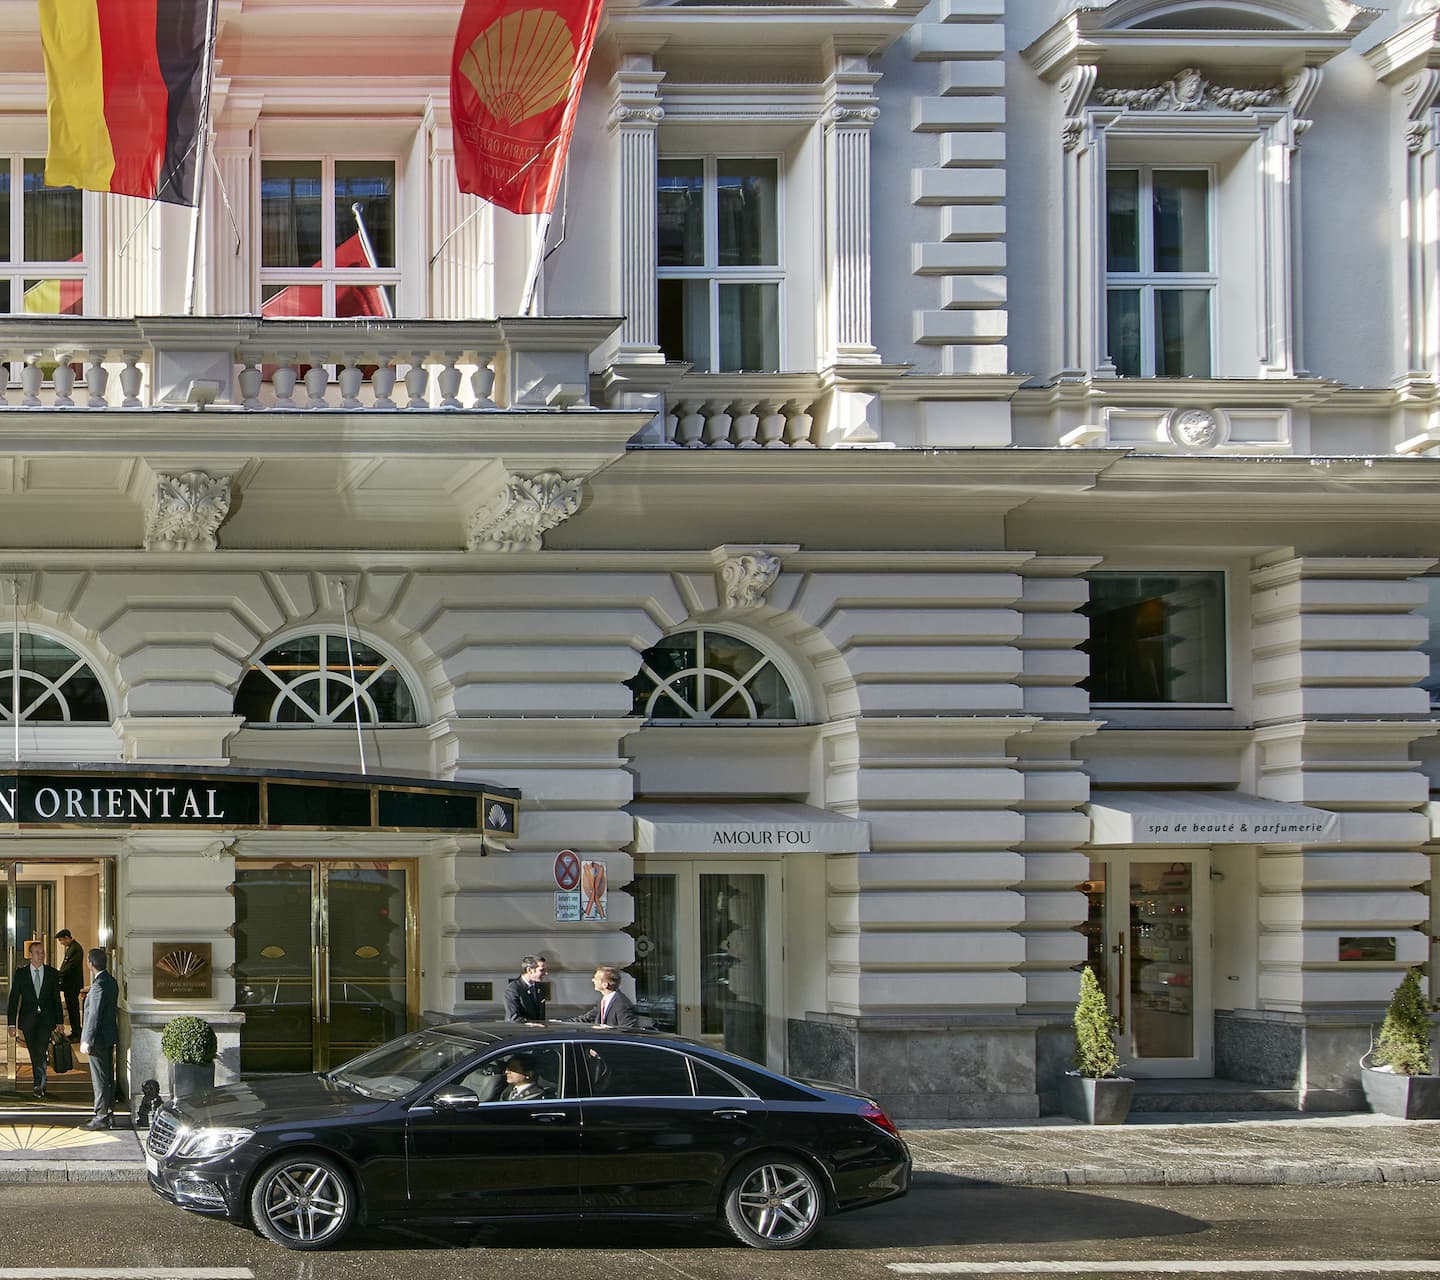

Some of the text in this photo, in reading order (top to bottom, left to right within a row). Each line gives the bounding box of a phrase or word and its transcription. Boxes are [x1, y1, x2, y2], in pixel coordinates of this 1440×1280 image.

[34, 787, 225, 819] ORIENTAL
[1149, 823, 1323, 834] spa de beauté & parfumerie
[712, 831, 811, 845] AMOUR FOU
